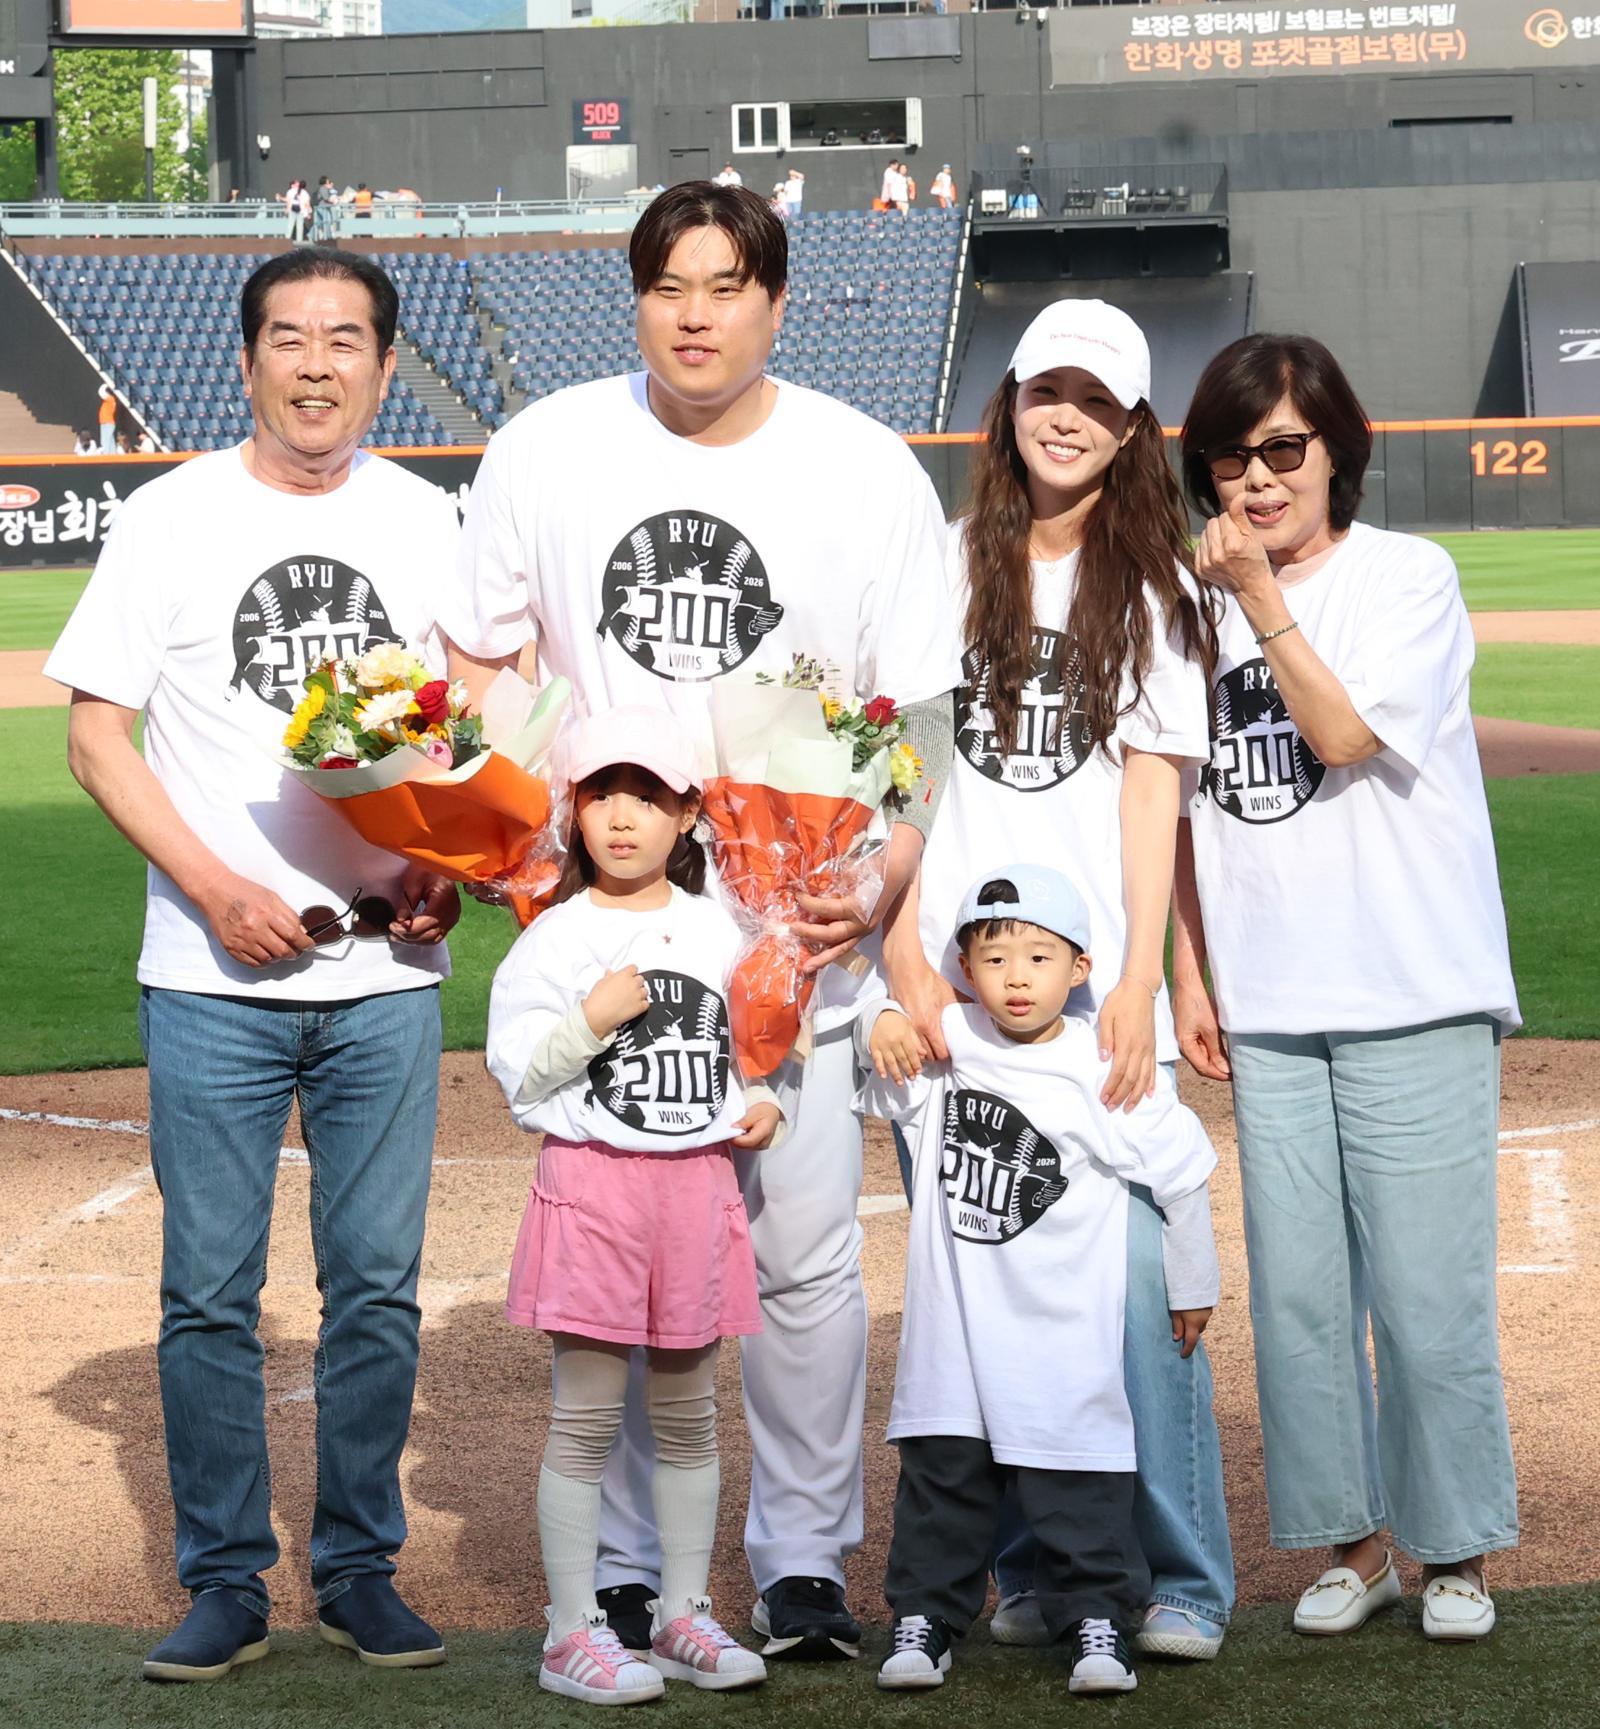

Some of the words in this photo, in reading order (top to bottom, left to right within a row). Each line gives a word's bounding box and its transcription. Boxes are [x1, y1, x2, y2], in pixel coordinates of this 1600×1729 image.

[1130, 14, 1191, 37] 보장은
[1194, 10, 1280, 35] 장타처럼!
[1284, 7, 1365, 31] 보험료는
[1368, 4, 1457, 29] 번트처럼!
[1123, 39, 1243, 72] 한화생명
[1250, 29, 1467, 67] 포켓골절보험(무)
[583, 102, 619, 125] 509
[1470, 440, 1548, 476] 122
[668, 518, 718, 547] RYU
[287, 563, 334, 589] RYU
[611, 561, 633, 571] 2006
[743, 576, 764, 588] 2026
[239, 612, 260, 622] 2006
[636, 586, 732, 650] 200
[669, 653, 702, 670] WINS
[1243, 665, 1279, 692] RY
[1011, 764, 1040, 781] WINS
[1219, 731, 1300, 792] 200
[1250, 795, 1282, 812] WINS
[621, 1049, 715, 1104] 200
[657, 1110, 692, 1125] WINS
[965, 1097, 1008, 1131] RYU
[1035, 1158, 1057, 1167] 2026
[958, 1211, 988, 1233] WINS
